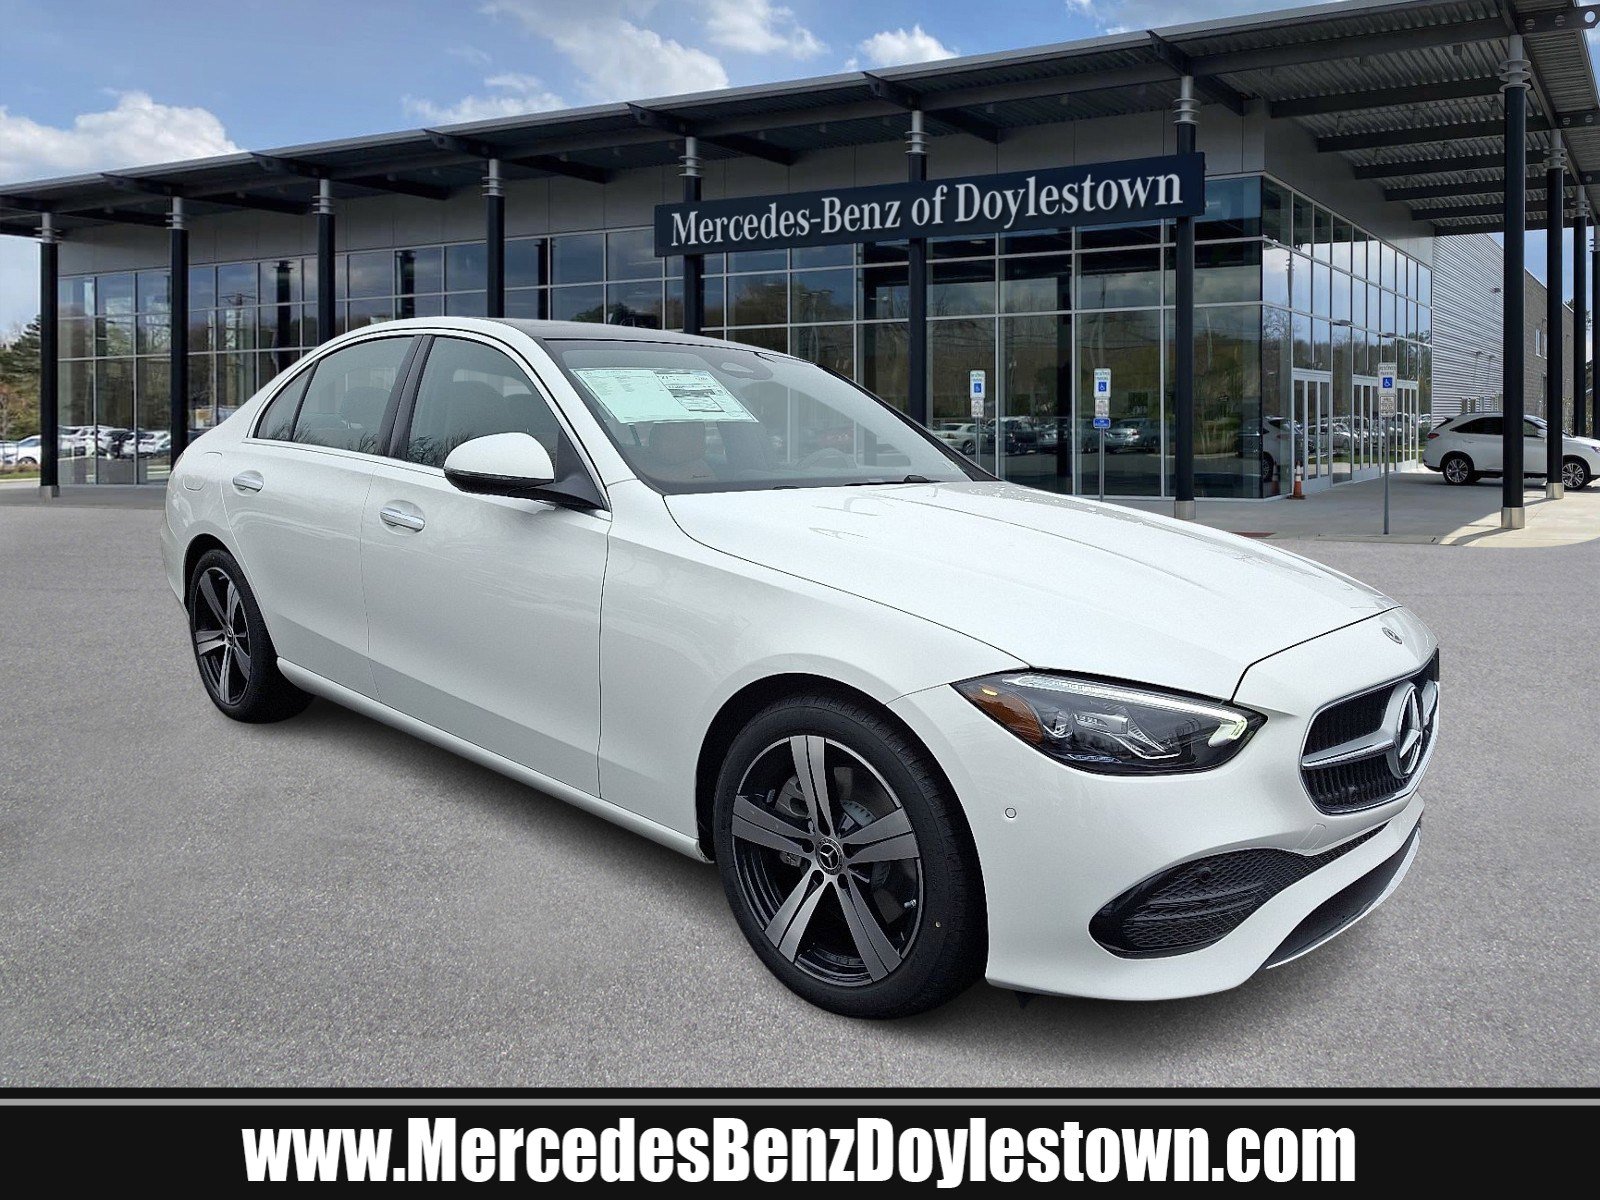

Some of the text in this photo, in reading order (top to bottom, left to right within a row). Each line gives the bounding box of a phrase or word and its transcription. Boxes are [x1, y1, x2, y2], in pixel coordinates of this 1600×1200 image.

[671, 173, 1183, 246] Mercedes-Benz of Doylestown
